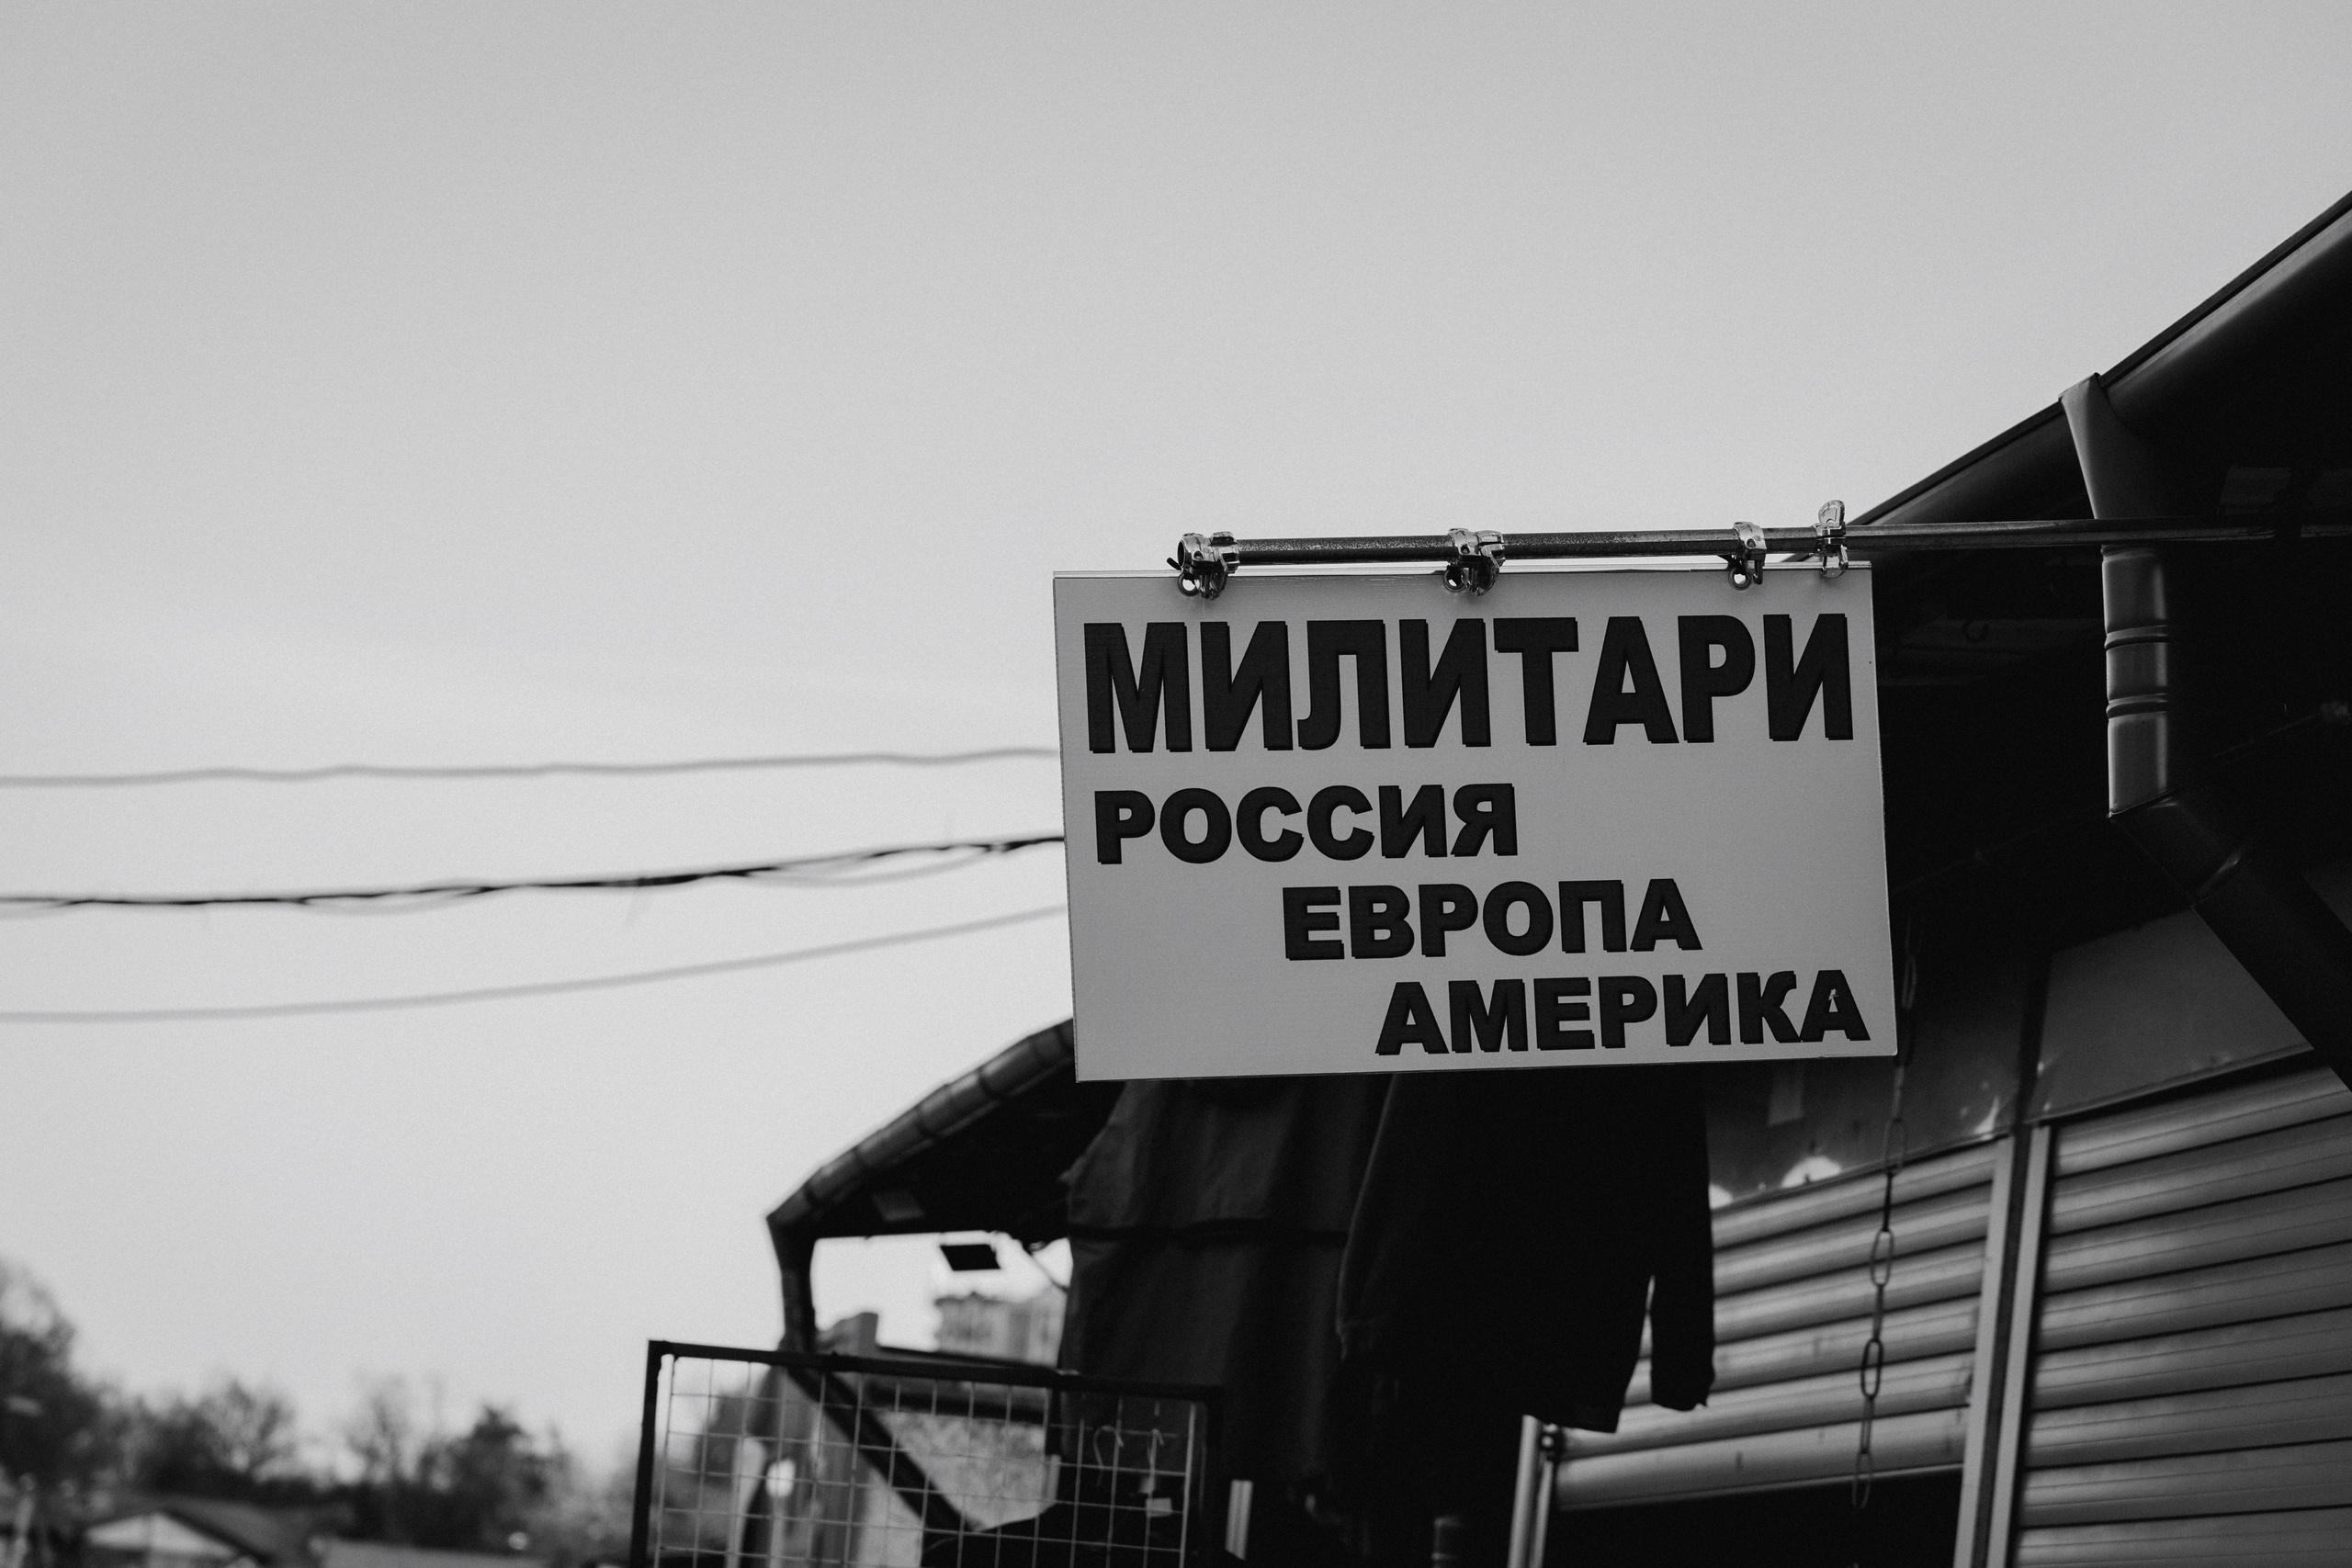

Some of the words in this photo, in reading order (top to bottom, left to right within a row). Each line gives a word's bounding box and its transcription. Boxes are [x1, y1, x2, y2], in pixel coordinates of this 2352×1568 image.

[1083, 613, 1854, 754] МИЛИТАРИ
[1093, 783, 1519, 865] РОССИЯ
[1282, 878, 1704, 962] ЕВРОПА
[1374, 969, 1871, 1056] АМЕРИКА
